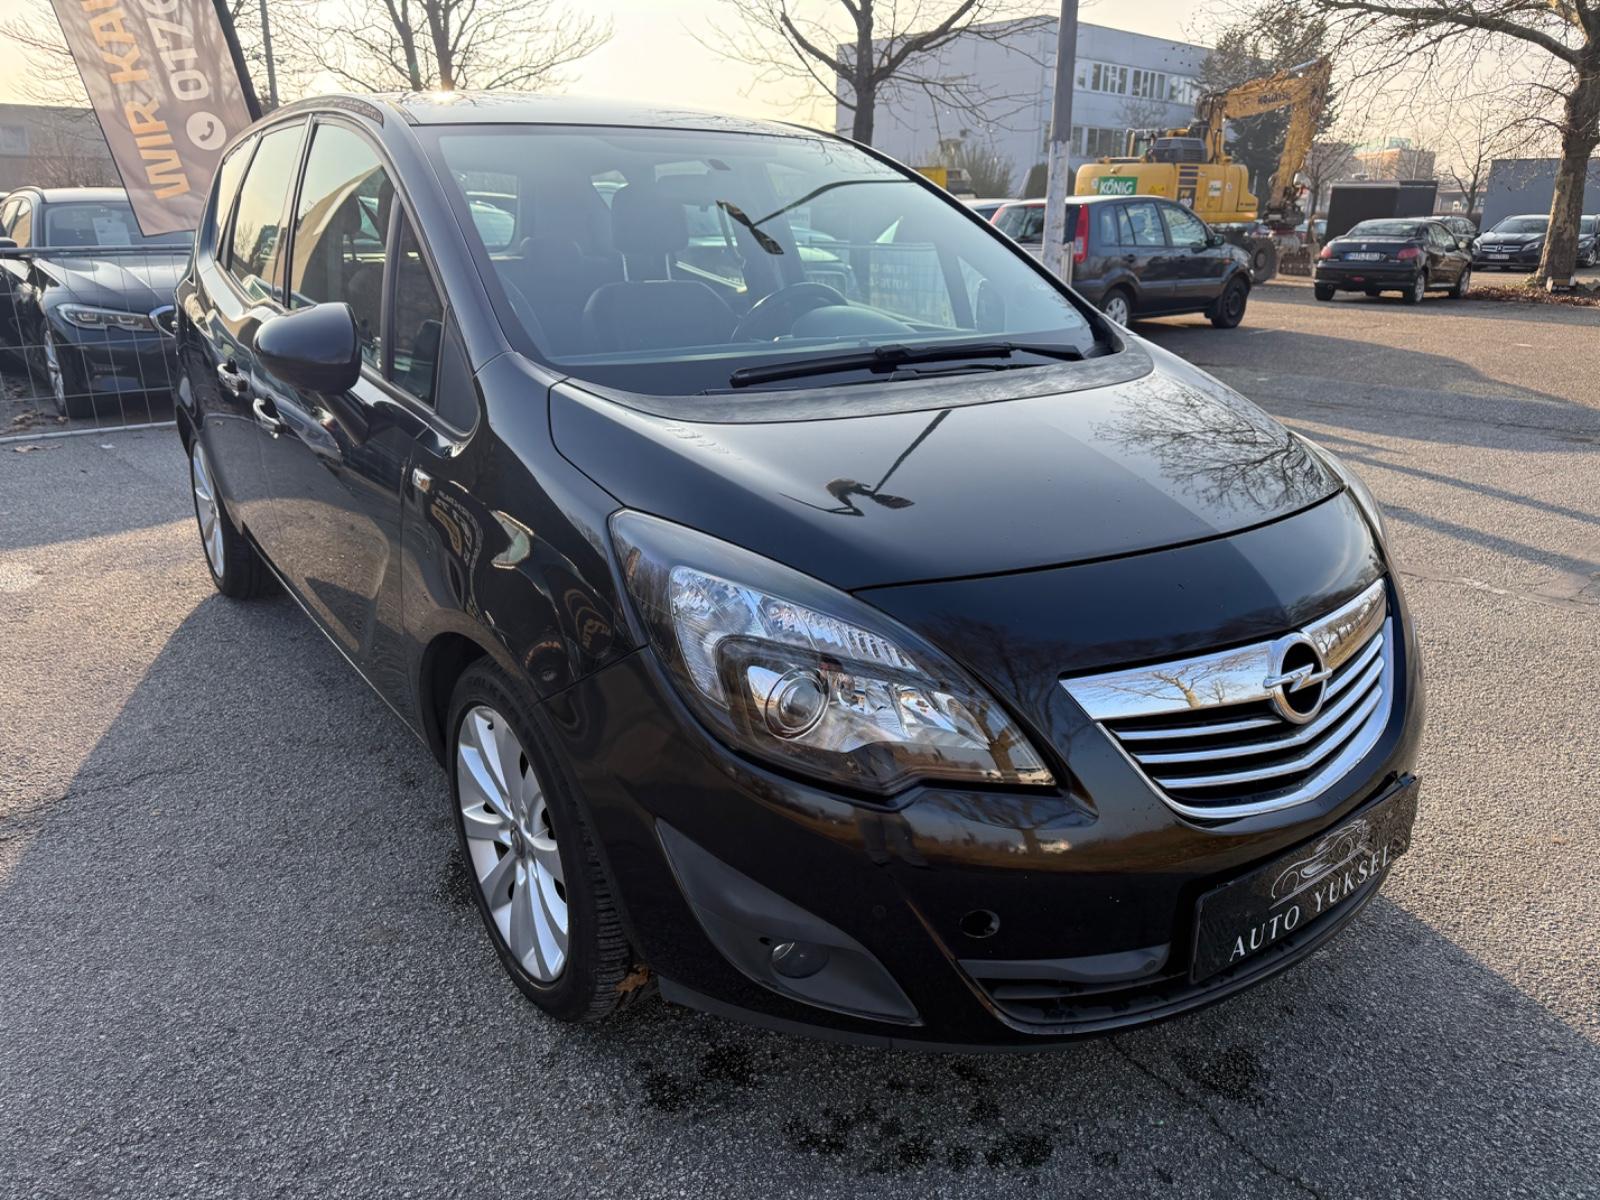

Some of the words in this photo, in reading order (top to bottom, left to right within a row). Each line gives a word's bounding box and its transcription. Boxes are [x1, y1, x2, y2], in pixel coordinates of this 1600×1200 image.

[124, 97, 191, 199] WIR
[1100, 178, 1133, 194] KÖNIG
[1229, 905, 1299, 962] AUTO
[1314, 846, 1391, 912] YUKSEL
